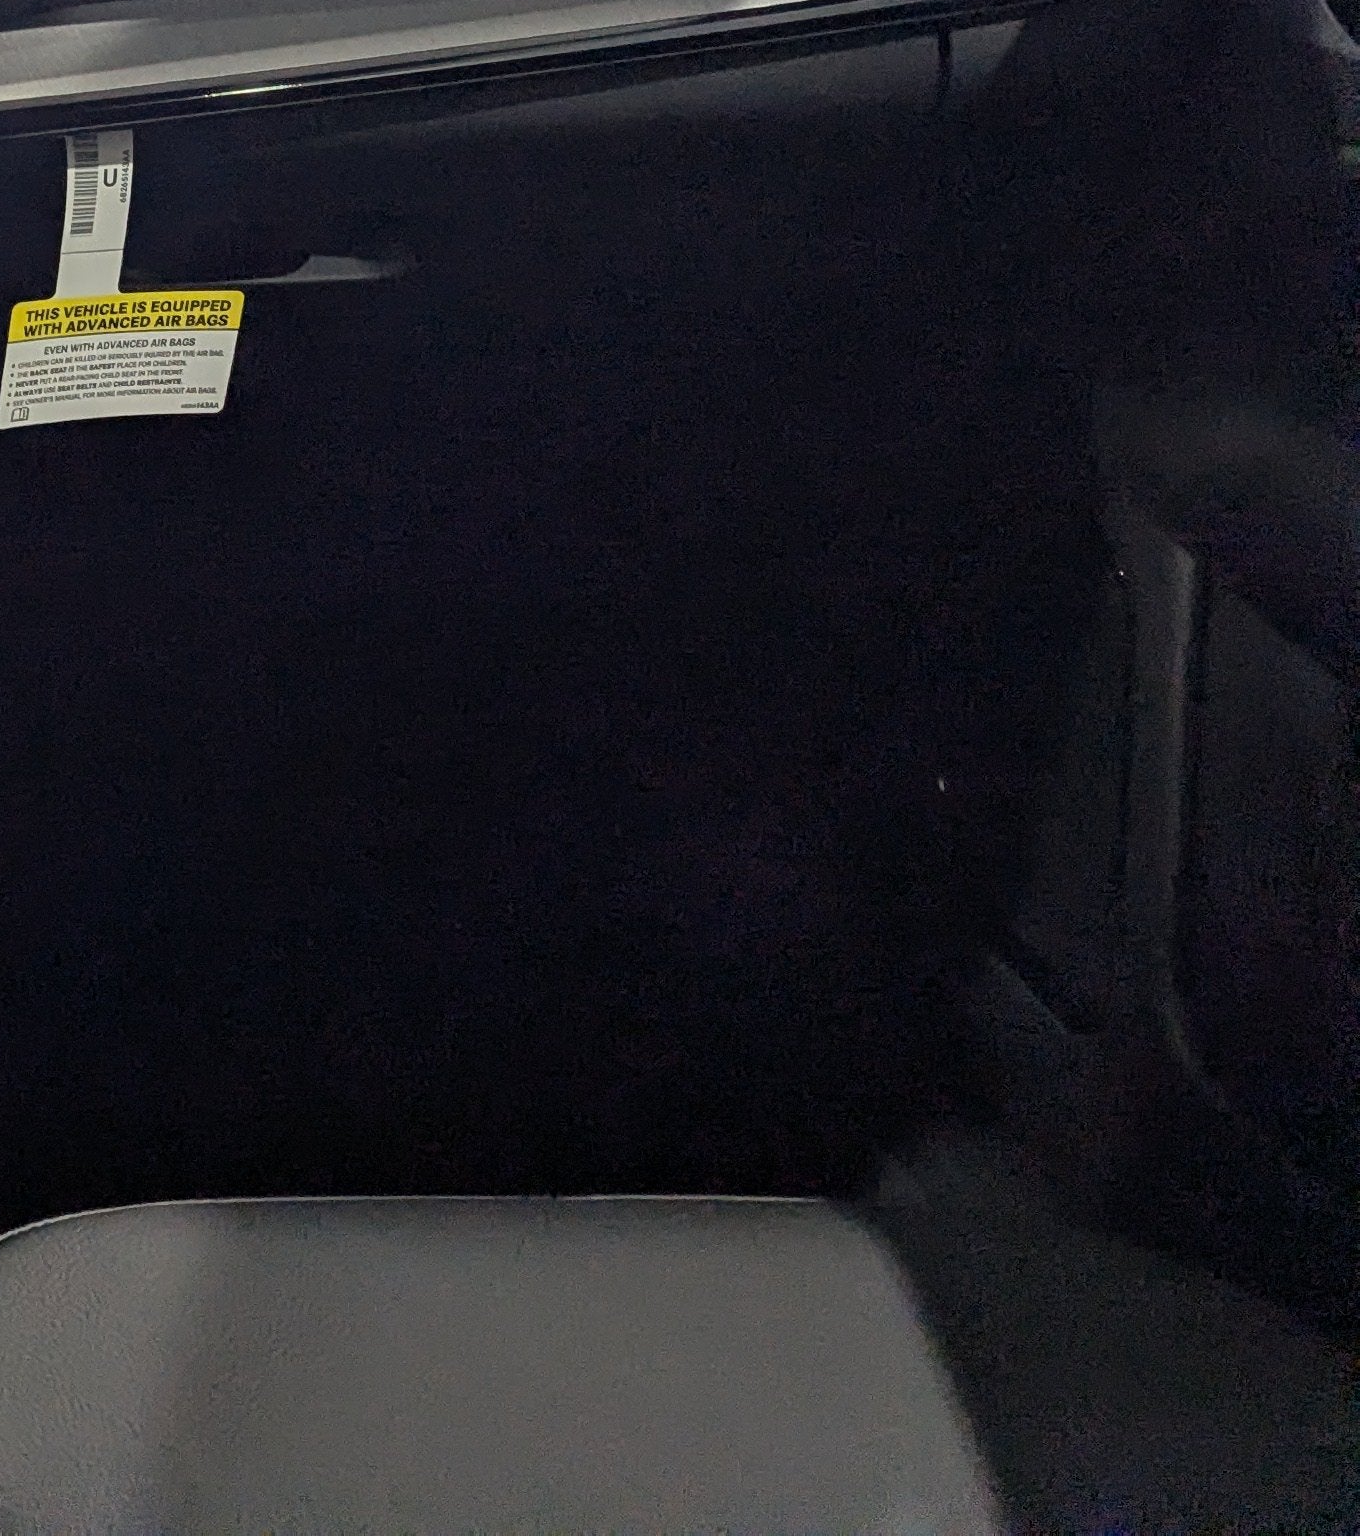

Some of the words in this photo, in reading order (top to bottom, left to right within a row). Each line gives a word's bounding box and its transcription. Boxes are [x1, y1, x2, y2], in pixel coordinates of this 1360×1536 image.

[103, 168, 118, 187] U
[26, 308, 60, 322] THIS
[64, 302, 128, 318] VEHICLE
[132, 301, 147, 313] IS
[151, 300, 231, 312] EQUIPPED
[24, 322, 62, 337] WITH
[65, 316, 151, 333] ADVANCED
[154, 315, 181, 327] AIR
[185, 315, 229, 326] BAGS
[44, 346, 68, 355] EVEN
[70, 343, 94, 352] WITH
[97, 339, 148, 350] ADVANCED
[151, 339, 167, 347] AIR
[170, 338, 196, 346] BAGS
[30, 368, 48, 376] BACK
